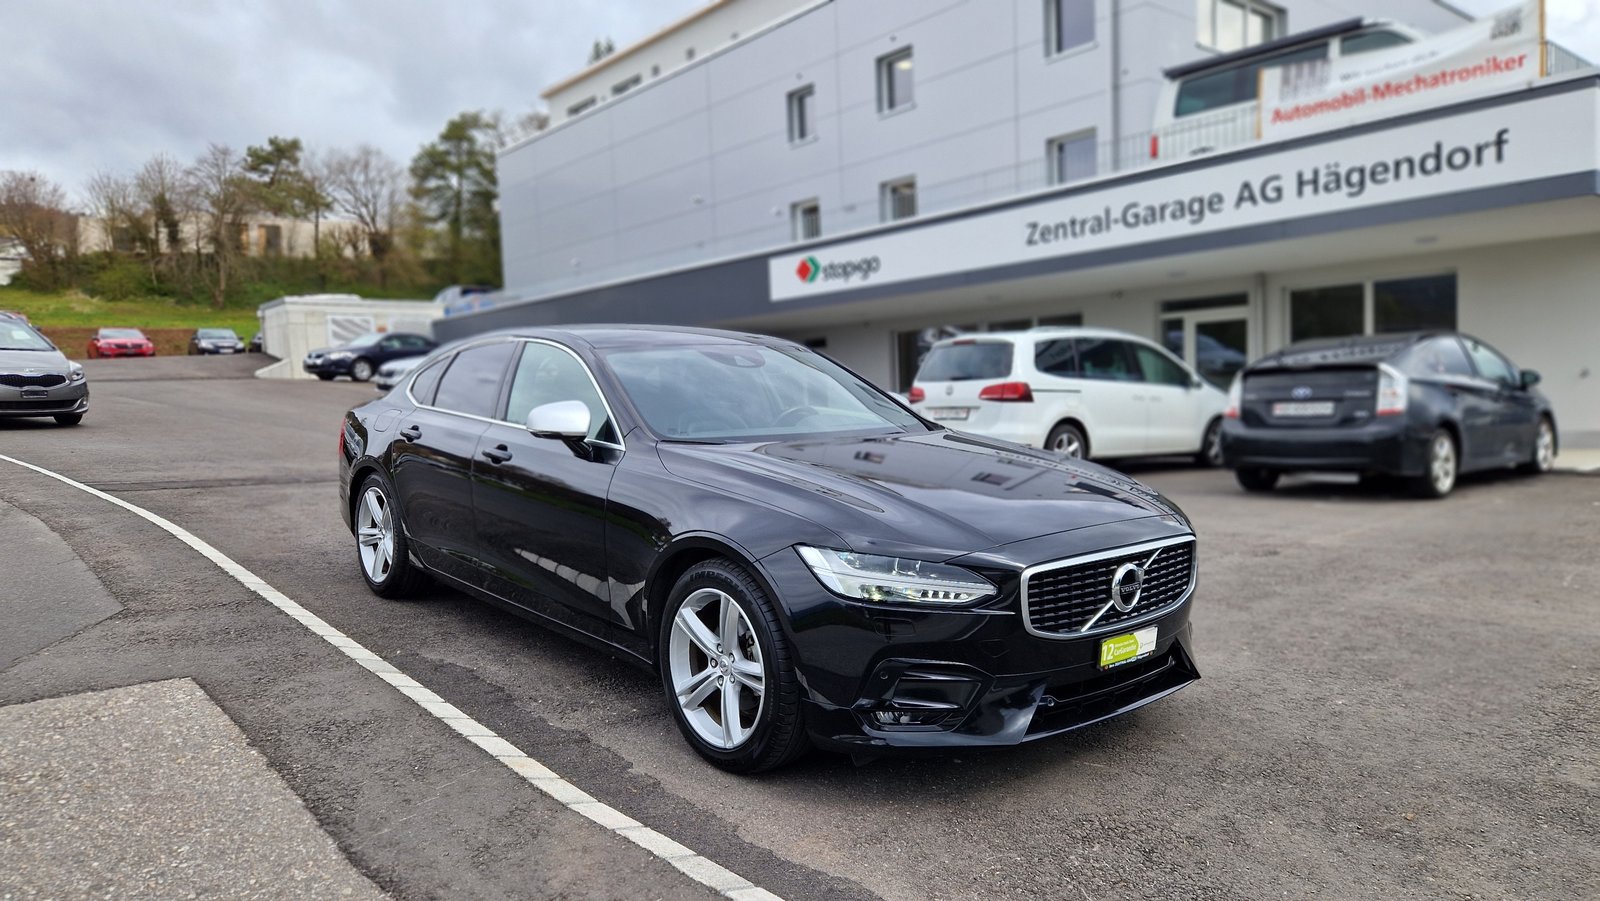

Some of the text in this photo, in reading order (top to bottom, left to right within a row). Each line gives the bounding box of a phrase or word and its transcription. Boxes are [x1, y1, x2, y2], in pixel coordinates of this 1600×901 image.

[1271, 53, 1527, 125] Automobil-Mechatroniker
[1025, 127, 1511, 246] Zentral-Garage AG Hägendorf
[1120, 584, 1140, 593] VOLVO
[1103, 643, 1115, 661] 12
